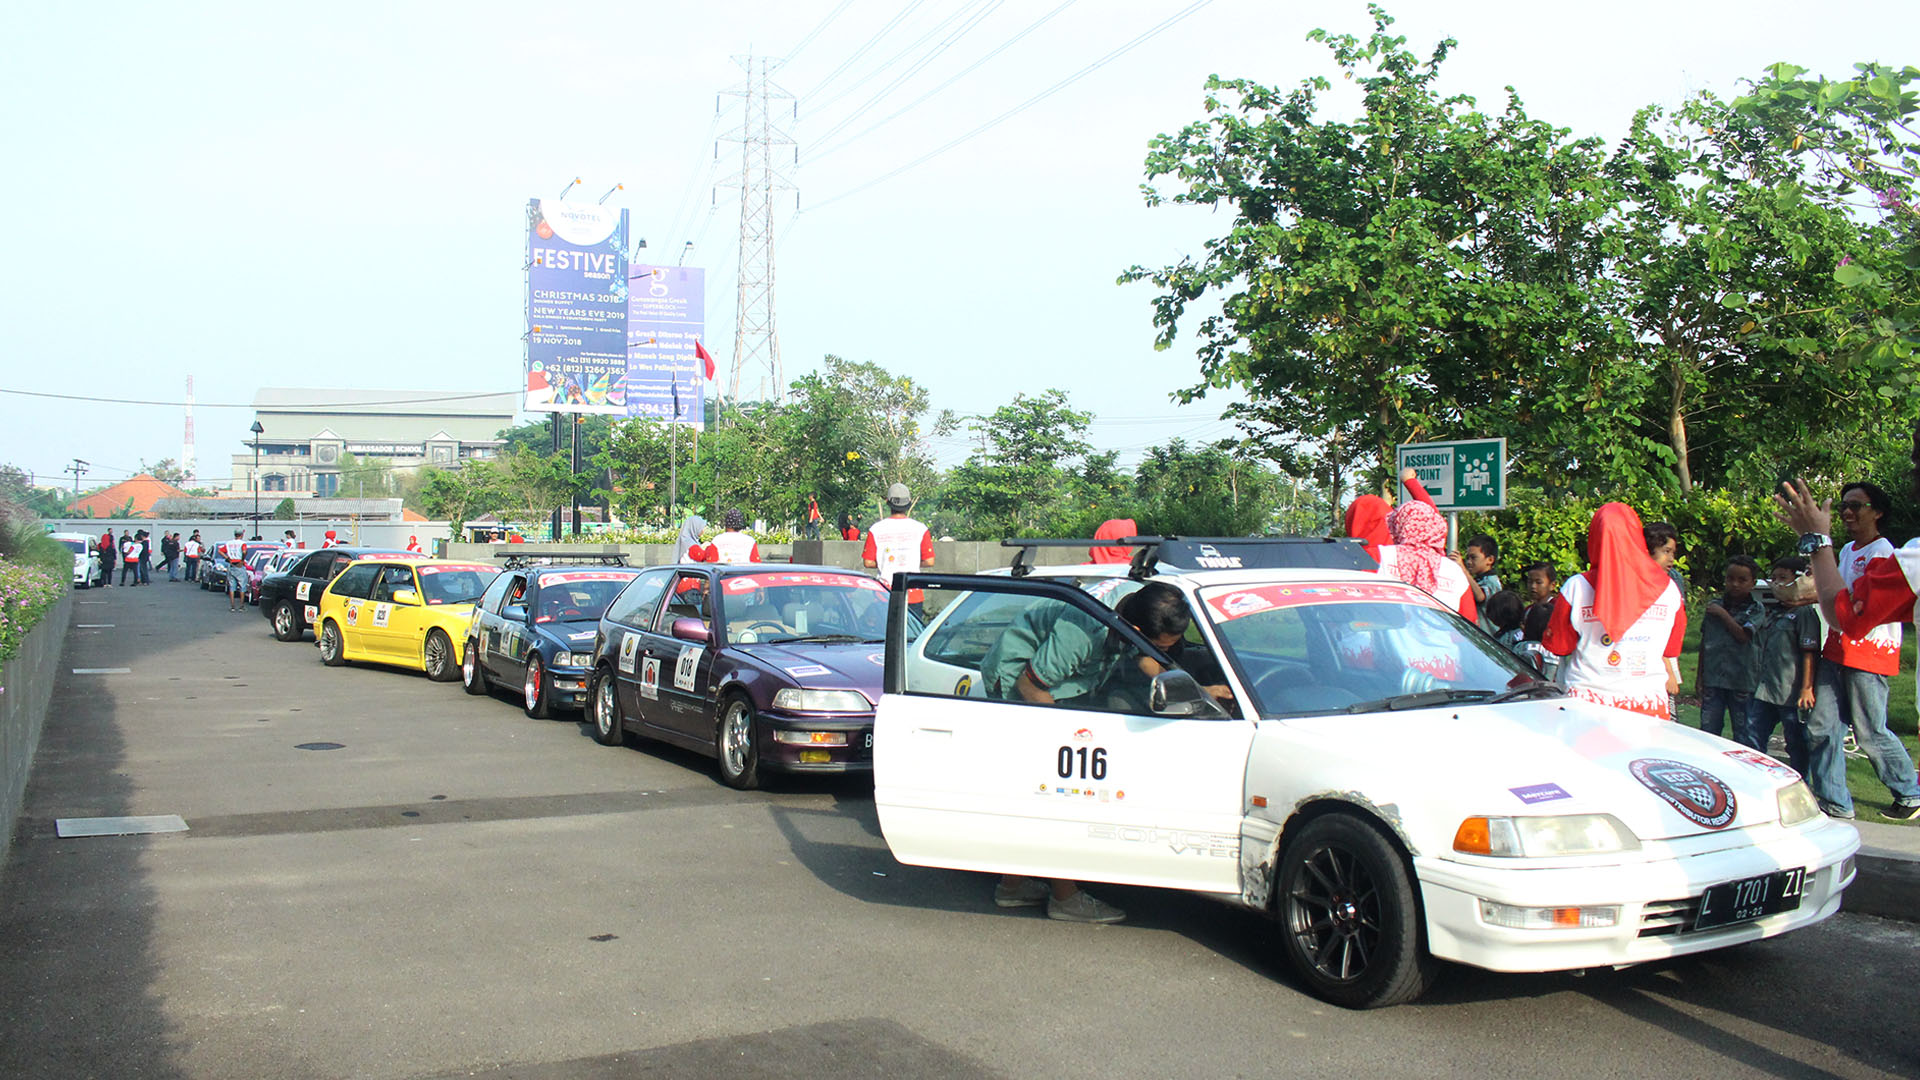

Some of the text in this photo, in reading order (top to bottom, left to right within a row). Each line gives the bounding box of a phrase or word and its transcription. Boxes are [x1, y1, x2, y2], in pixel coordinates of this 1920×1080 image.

[560, 212, 602, 222] NOVOTEL
[533, 248, 616, 274] FESTIVE
[534, 290, 620, 304] CHRISTMAS 2018
[533, 307, 556, 315] NEW
[557, 308, 586, 317] YEARS
[589, 310, 605, 318] EVE
[606, 311, 626, 320] 2019
[543, 338, 562, 346] NOV
[545, 364, 626, 375] +62 (812) 3266 1365
[394, 446, 424, 454] SCHOOL
[1405, 453, 1450, 467] ASSEMBLY
[1416, 468, 1441, 481] POINT
[1195, 556, 1243, 569] THULE
[680, 657, 694, 678] 018
[865, 733, 873, 748] B
[1057, 745, 1108, 781] 016
[1660, 773, 1694, 783] ECO
[1660, 791, 1712, 826] DISTRIBUTOR
[1168, 844, 1240, 859] VTEC
[1701, 890, 1712, 916] L
[1733, 877, 1770, 909] 1701
